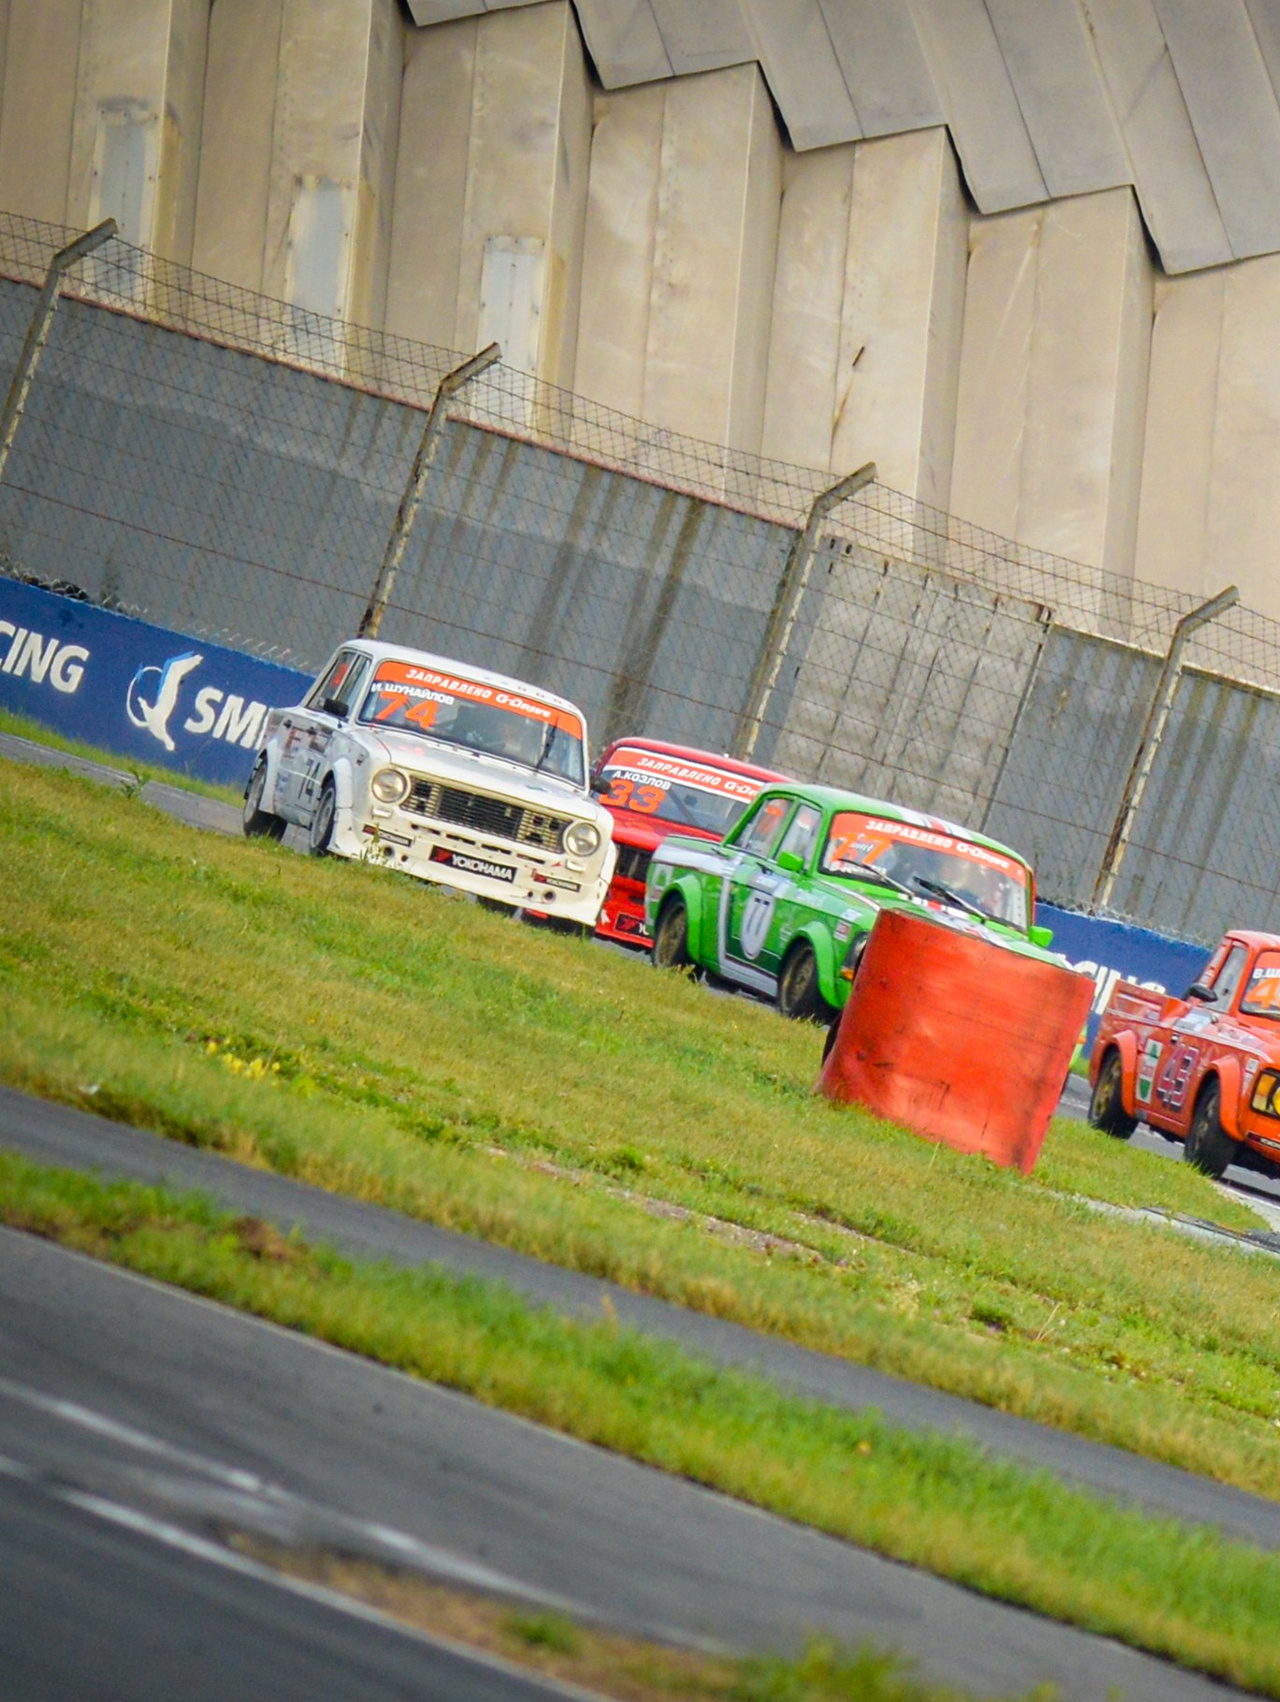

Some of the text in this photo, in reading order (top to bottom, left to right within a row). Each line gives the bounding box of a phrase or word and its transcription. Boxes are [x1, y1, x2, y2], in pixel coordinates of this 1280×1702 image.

[406, 669, 492, 698] ЗАПРАВЛЕНО
[376, 691, 438, 729] 74
[612, 771, 671, 790] А.КОЗЛОВ
[637, 757, 721, 786] ЗАПРАВЛЕНО
[598, 778, 666, 813] 33
[865, 820, 953, 848] ЗАПРАВЛЕНО
[451, 854, 513, 880] YOKOHAMA
